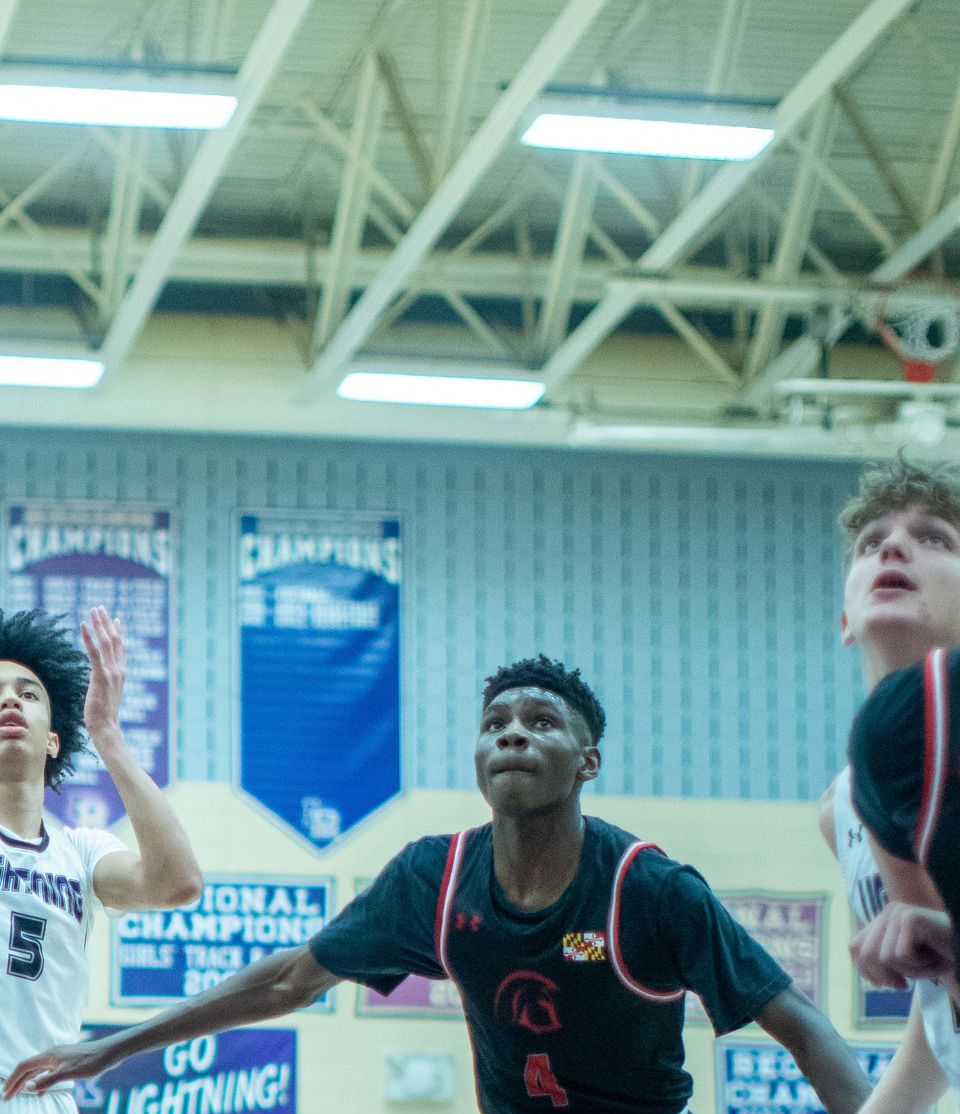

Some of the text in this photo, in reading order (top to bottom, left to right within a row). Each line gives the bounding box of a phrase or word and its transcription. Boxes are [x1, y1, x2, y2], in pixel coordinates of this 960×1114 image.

[9, 527, 169, 574] CHAMPIONS
[241, 532, 398, 584] CHAMPIONS
[6, 911, 47, 981] 5
[164, 1034, 216, 1077] GO
[524, 1053, 568, 1107] 4
